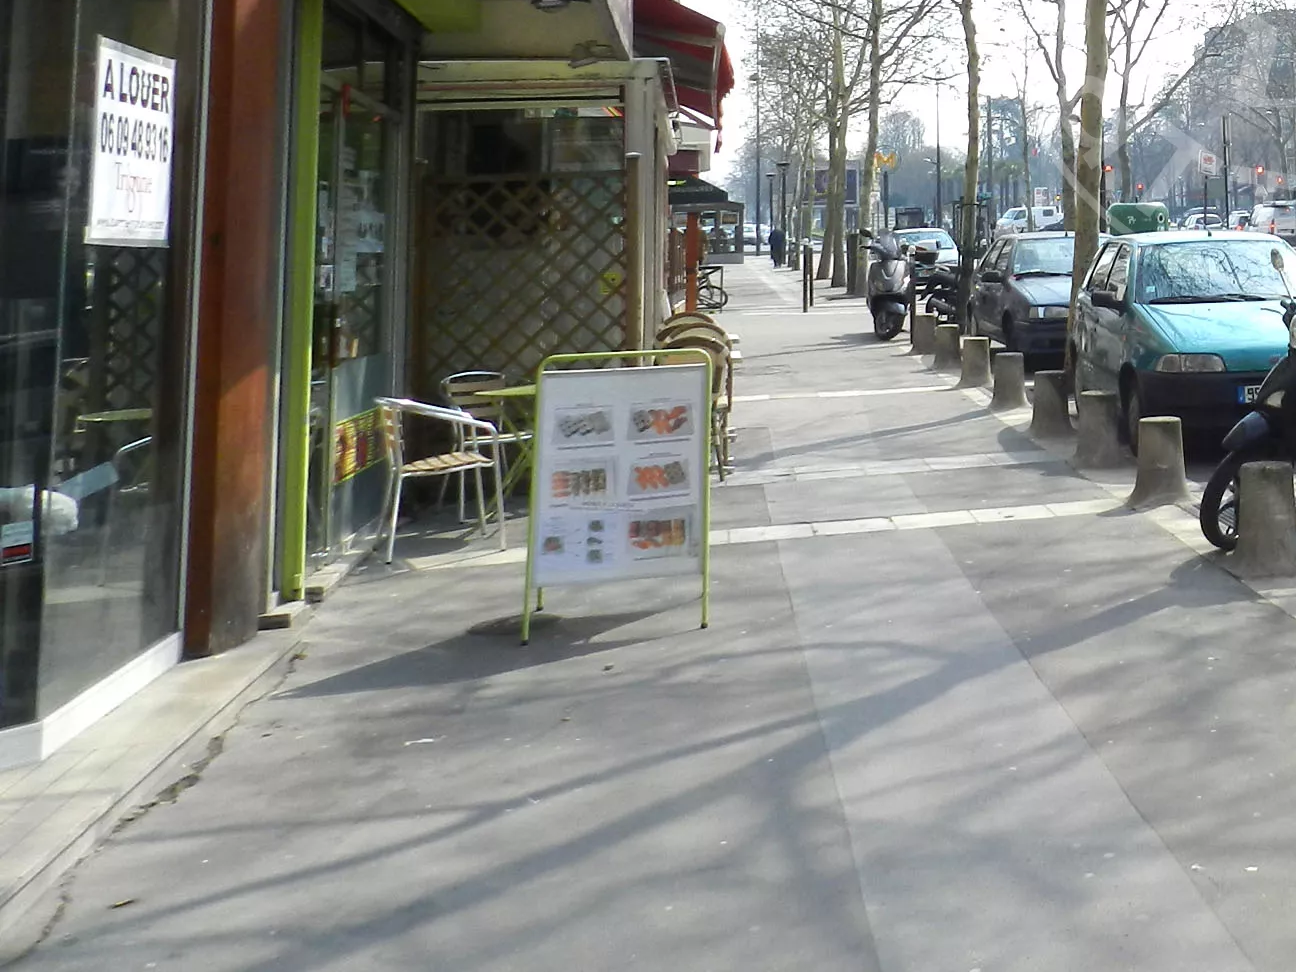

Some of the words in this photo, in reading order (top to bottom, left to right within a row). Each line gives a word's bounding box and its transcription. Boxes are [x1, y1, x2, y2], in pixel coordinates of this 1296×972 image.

[102, 58, 115, 101] A
[119, 62, 170, 114] LOUER
[100, 112, 115, 155] 06
[116, 115, 130, 157] 09
[131, 119, 143, 159] 48
[144, 121, 157, 161] 93
